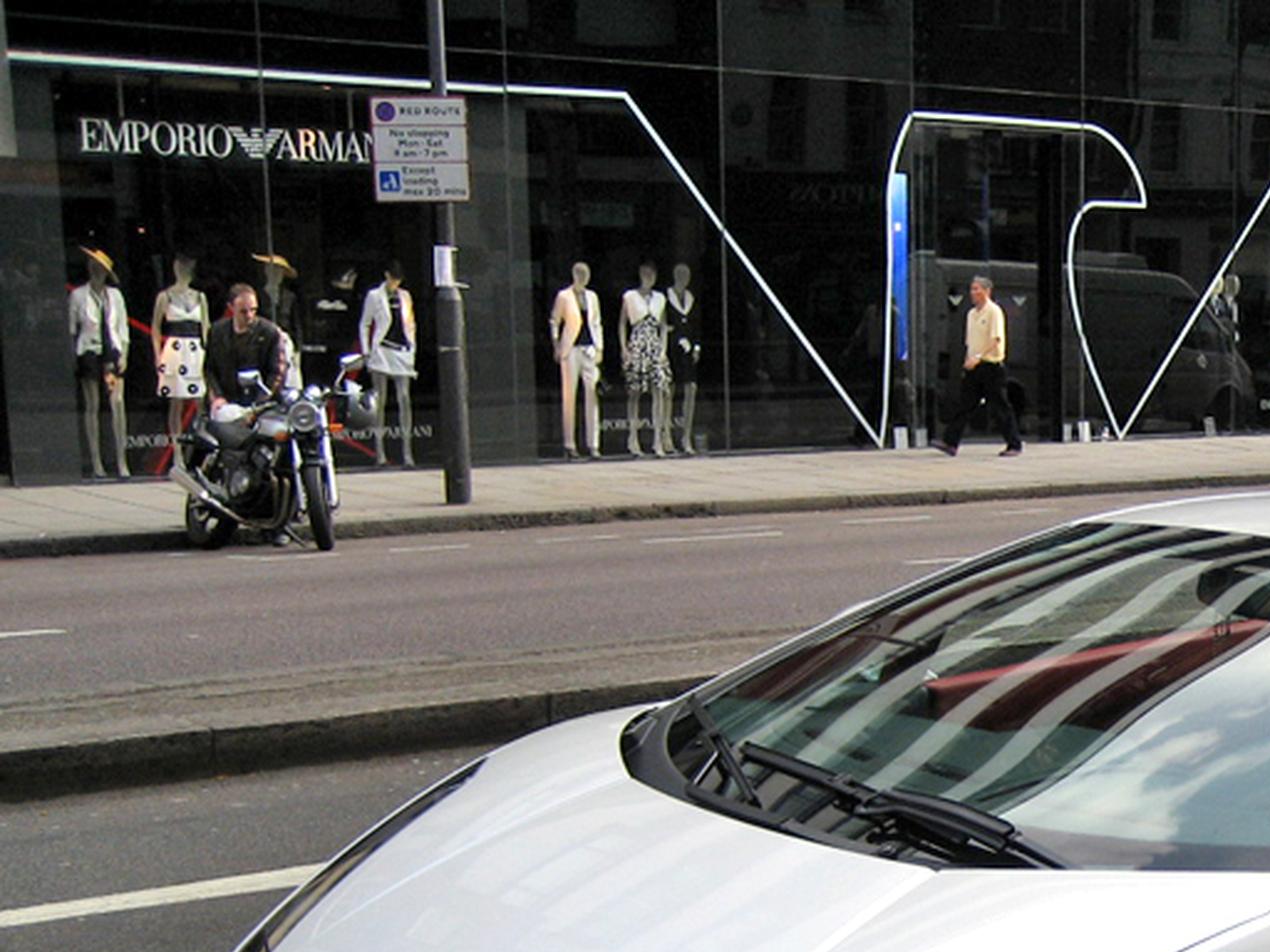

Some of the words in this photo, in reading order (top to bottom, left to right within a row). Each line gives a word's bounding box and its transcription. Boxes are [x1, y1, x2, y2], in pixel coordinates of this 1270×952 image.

[399, 106, 422, 116] RED
[424, 106, 461, 116] ROUTE
[80, 118, 233, 158] EMPORIO
[276, 129, 372, 164] ARMA
